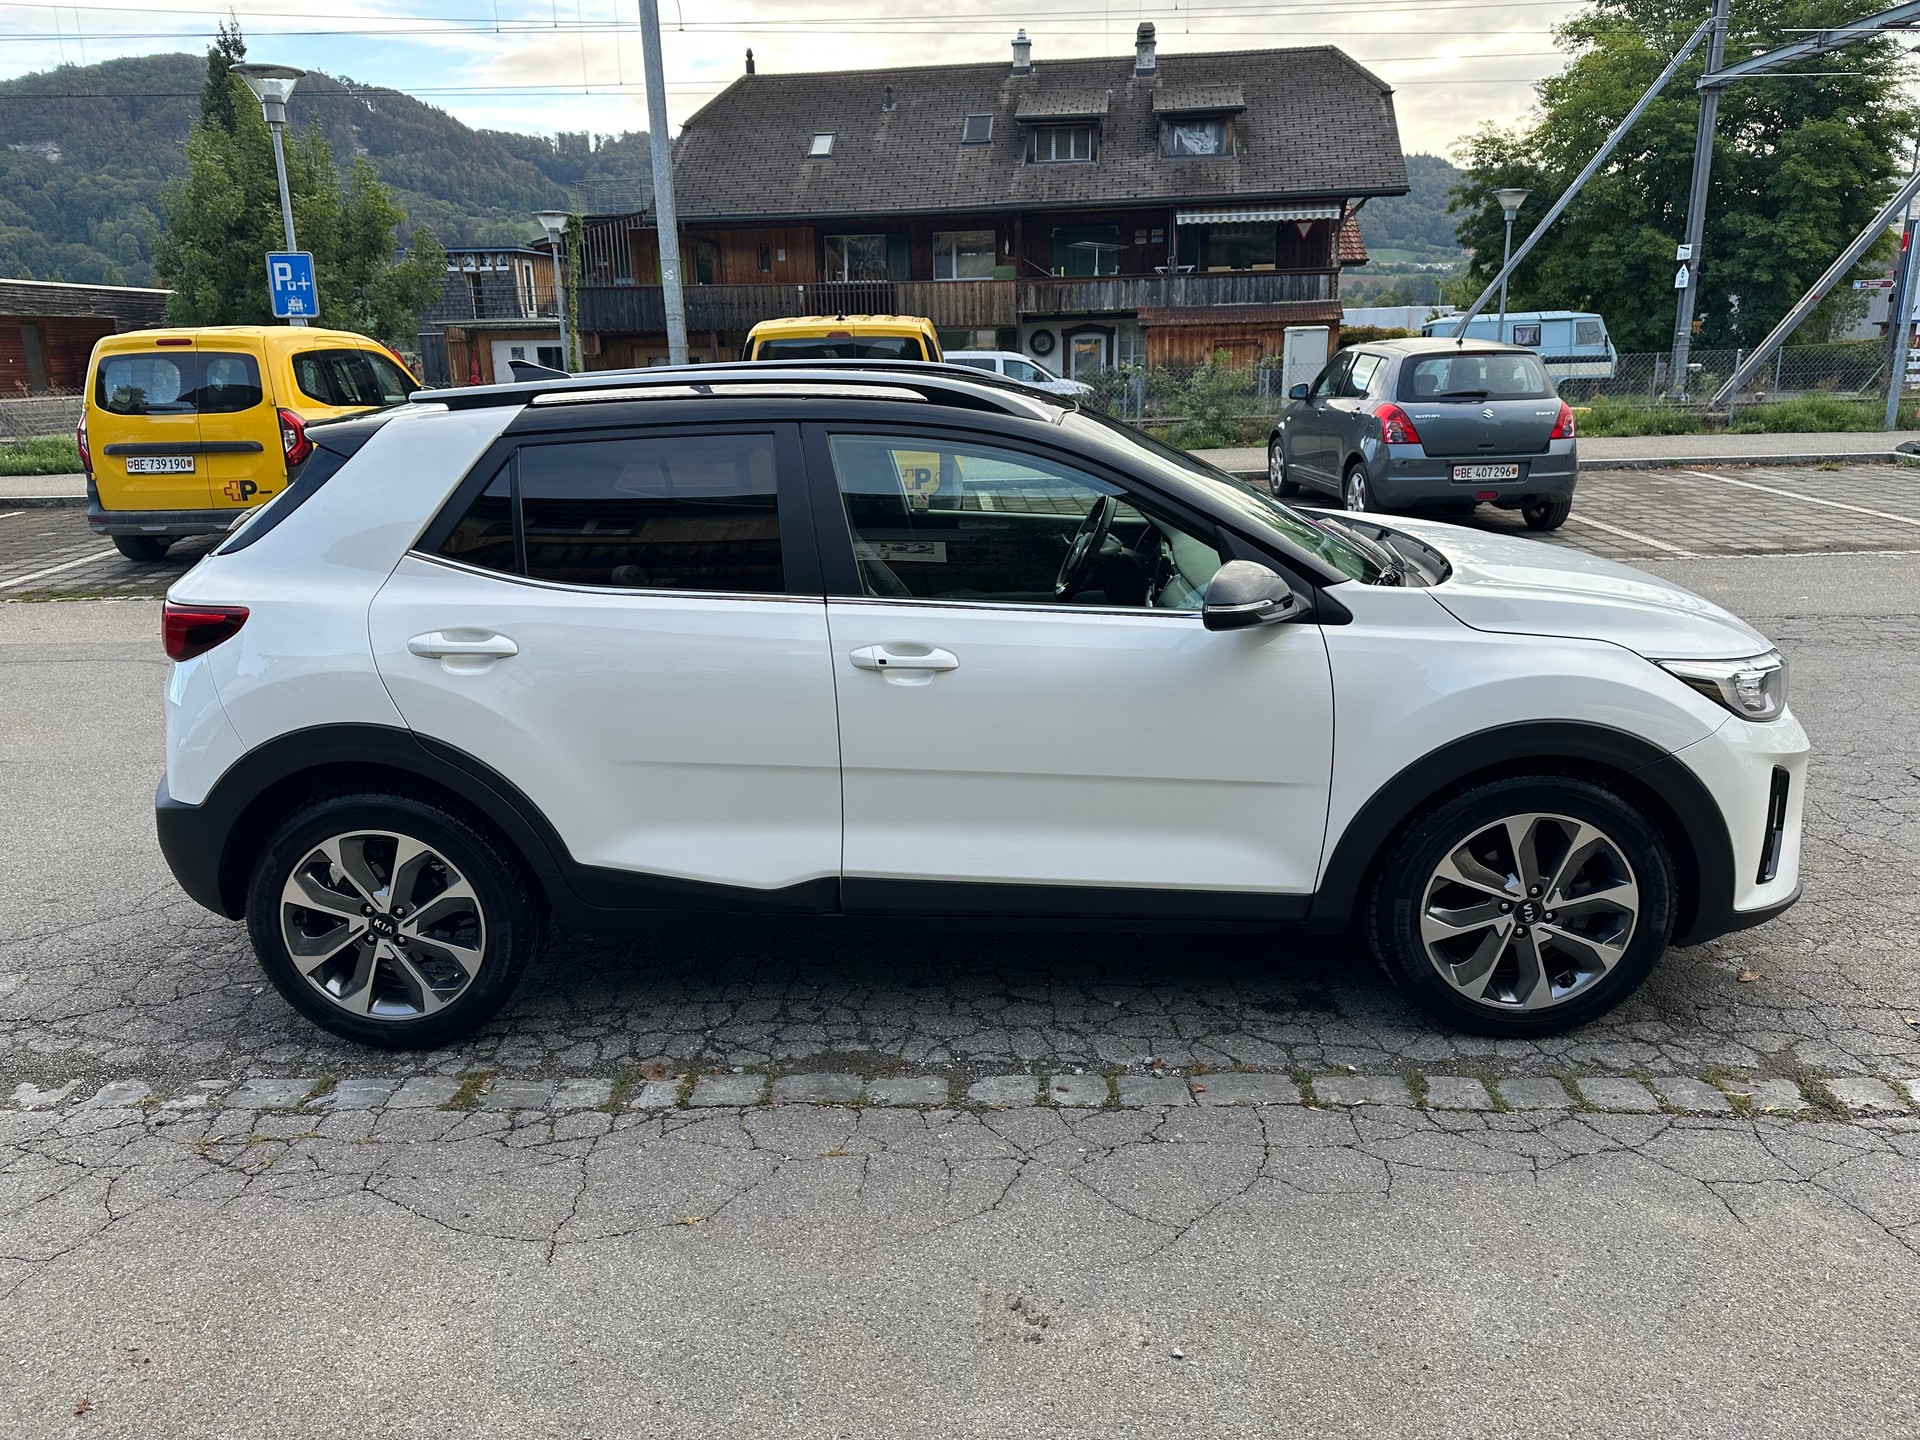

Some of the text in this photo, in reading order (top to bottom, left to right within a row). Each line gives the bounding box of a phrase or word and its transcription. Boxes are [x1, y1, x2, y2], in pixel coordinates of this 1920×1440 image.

[273, 263, 292, 290] P
[1680, 268, 1685, 278] 6
[914, 468, 931, 489] P
[1523, 903, 1534, 922] KIA
[373, 918, 392, 934] KIA
